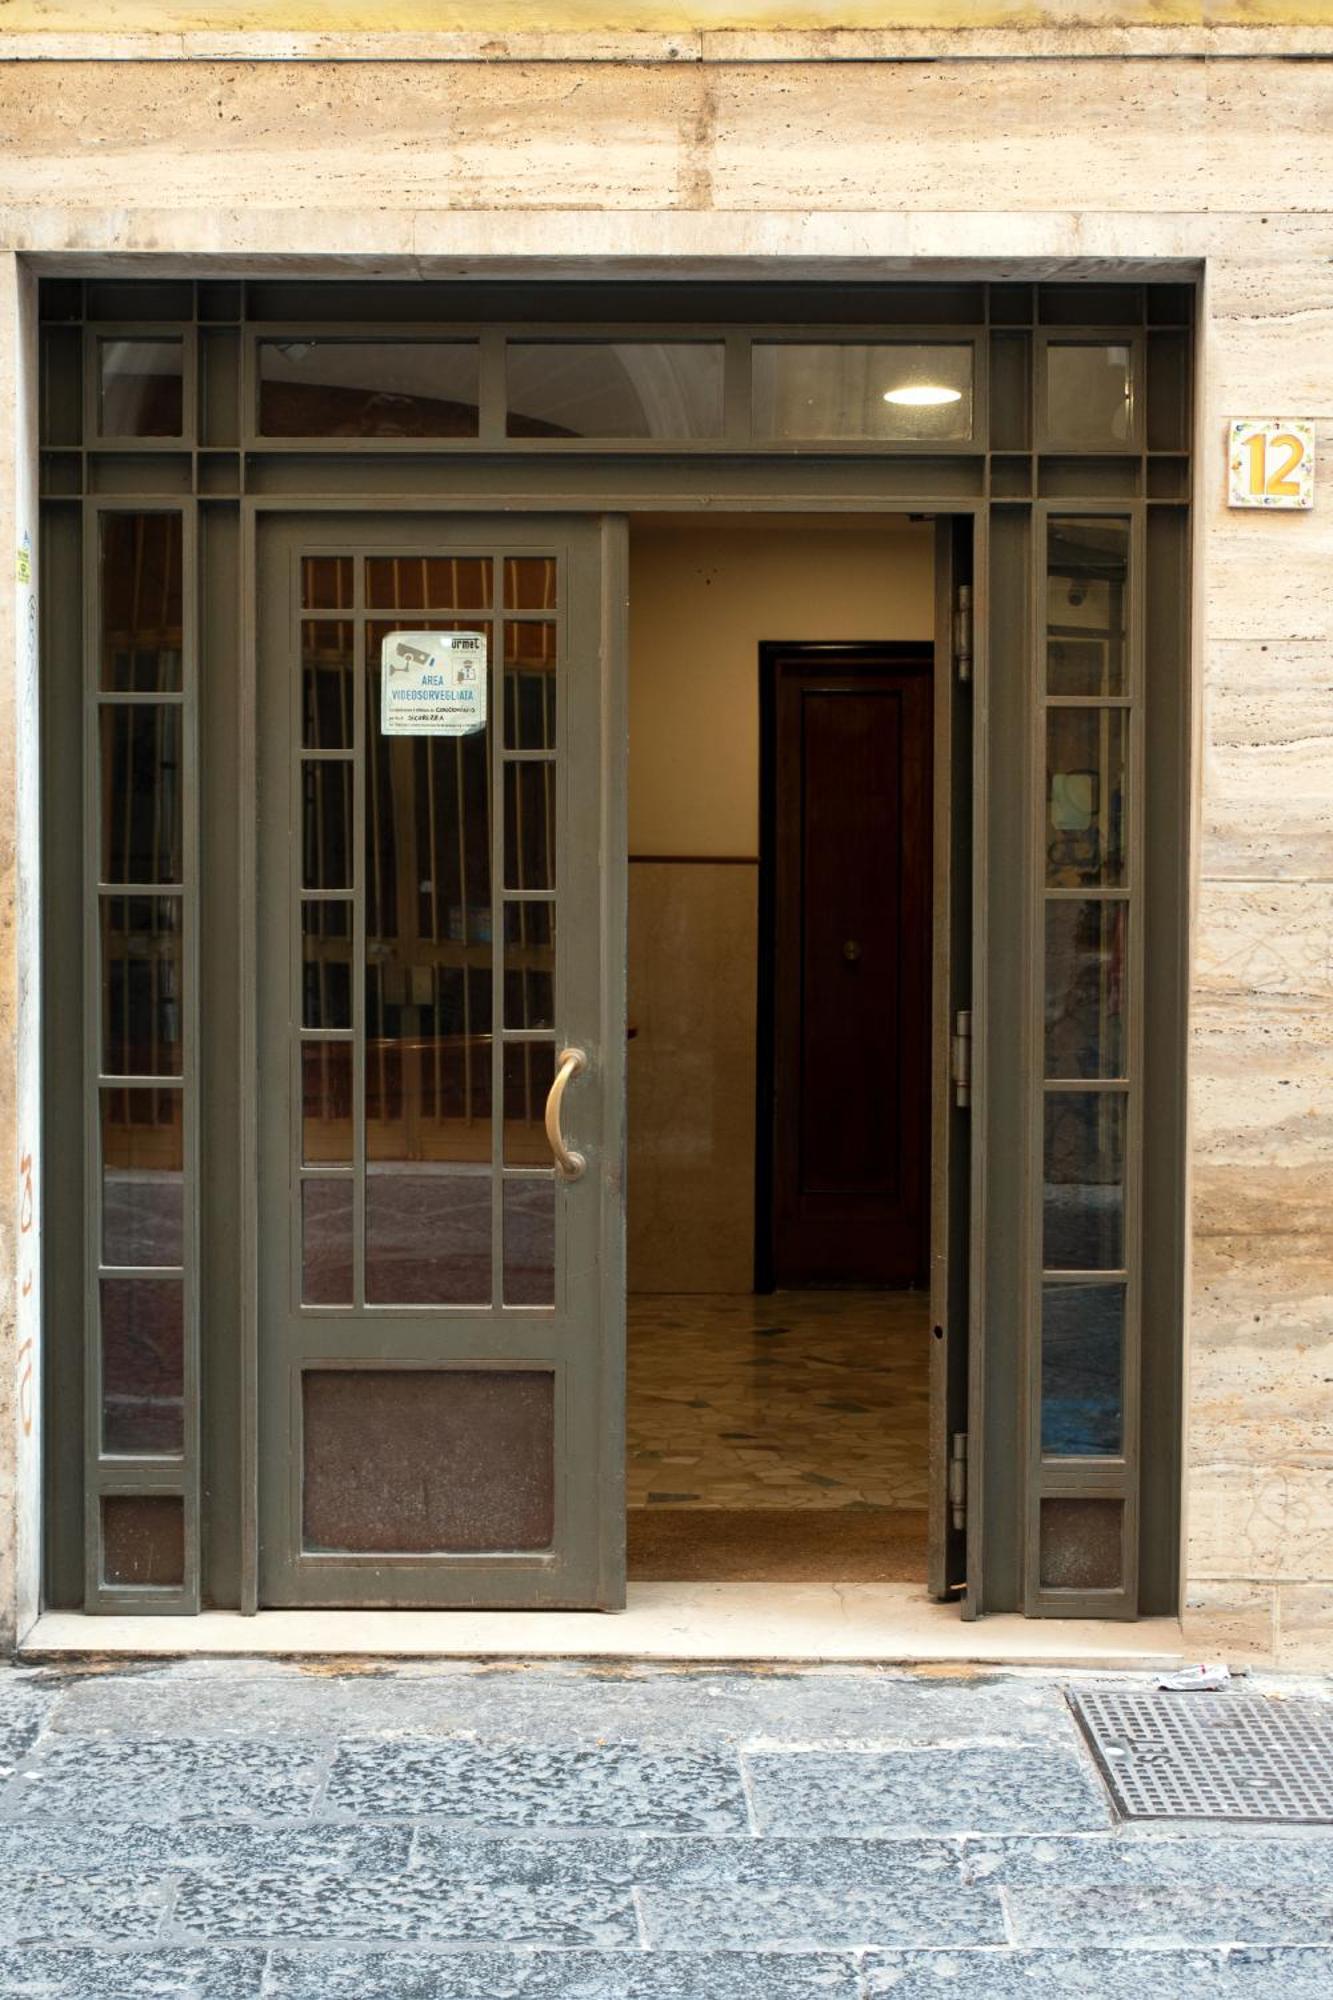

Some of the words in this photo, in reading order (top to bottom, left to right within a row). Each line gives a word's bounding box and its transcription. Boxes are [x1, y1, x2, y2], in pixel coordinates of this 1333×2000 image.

[1242, 433, 1304, 496] 12
[451, 638, 480, 649] urmet
[421, 674, 444, 686] AREA
[391, 689, 474, 701] VIDEOSORVEGLIATA
[1127, 1737, 1174, 1765] SET
